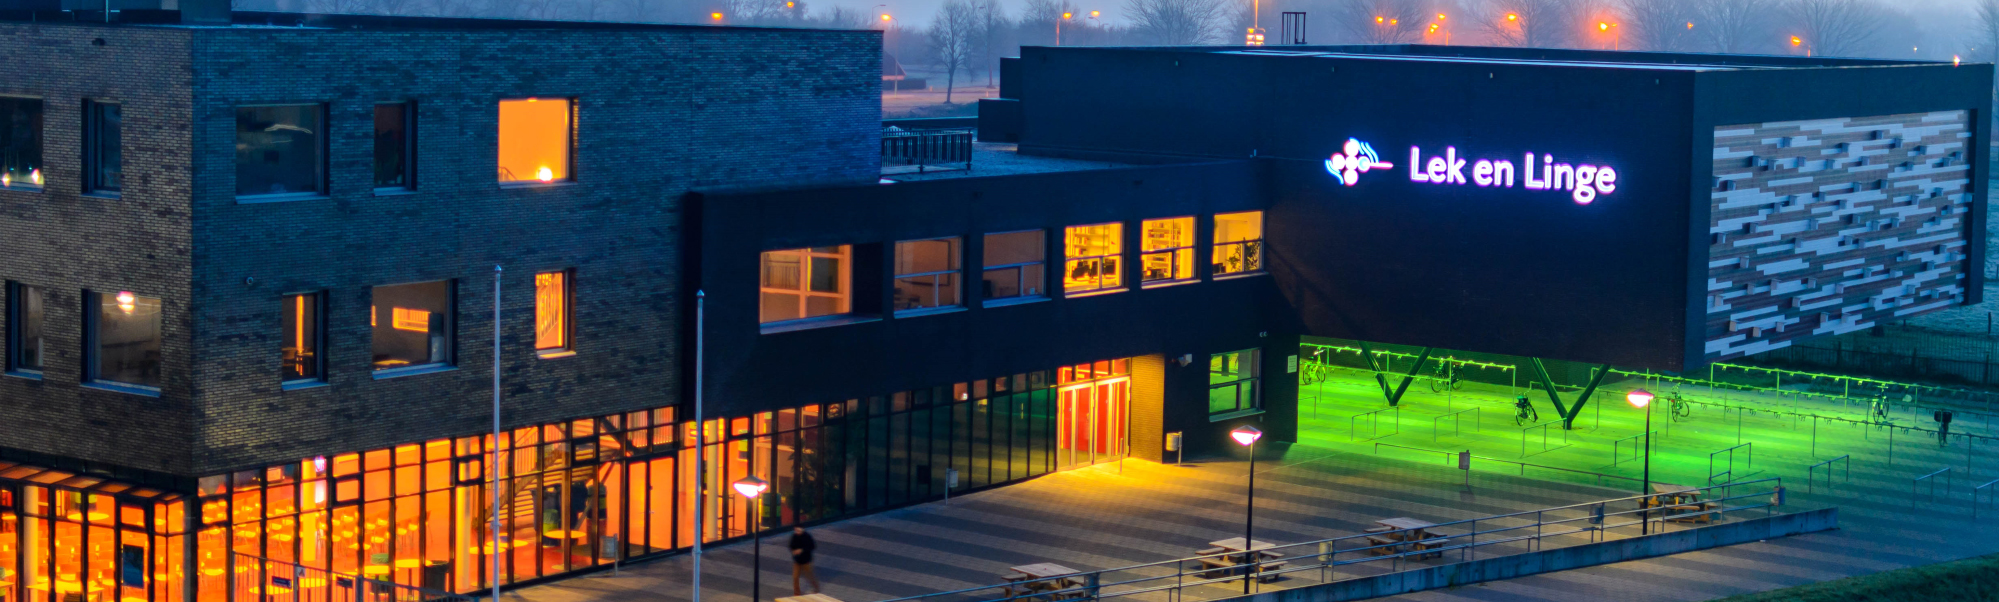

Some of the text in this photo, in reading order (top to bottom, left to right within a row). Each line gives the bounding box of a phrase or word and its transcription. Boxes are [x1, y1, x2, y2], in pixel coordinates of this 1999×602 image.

[1411, 146, 1616, 204] Lek en Linge
